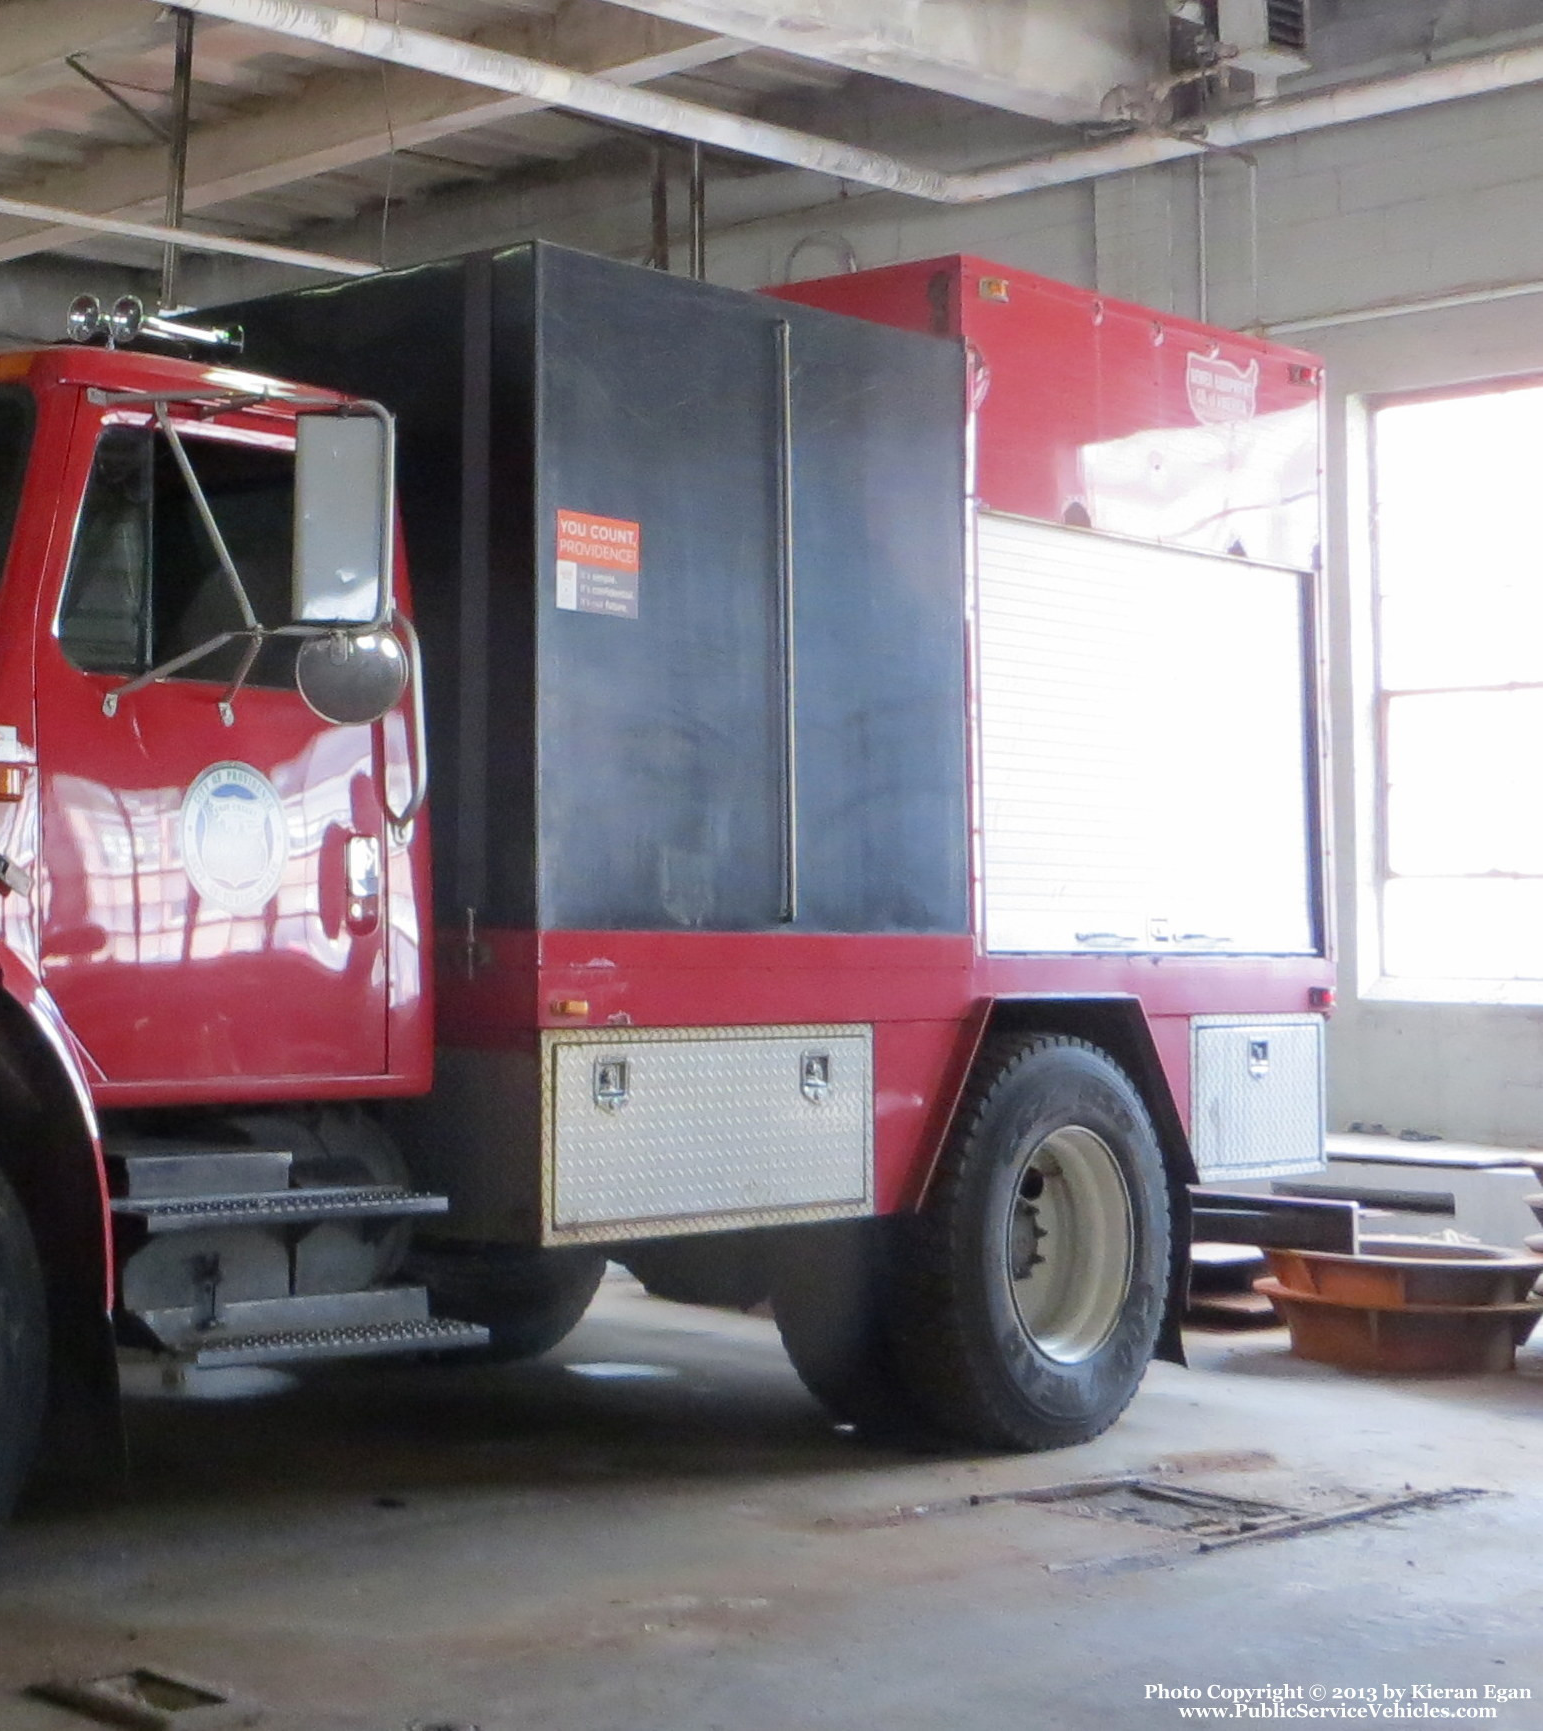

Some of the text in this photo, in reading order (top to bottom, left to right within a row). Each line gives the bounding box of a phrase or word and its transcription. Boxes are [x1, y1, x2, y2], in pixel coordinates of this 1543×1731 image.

[559, 519, 637, 547] YOU COUNT,
[559, 538, 637, 564] PROVIDENCE!
